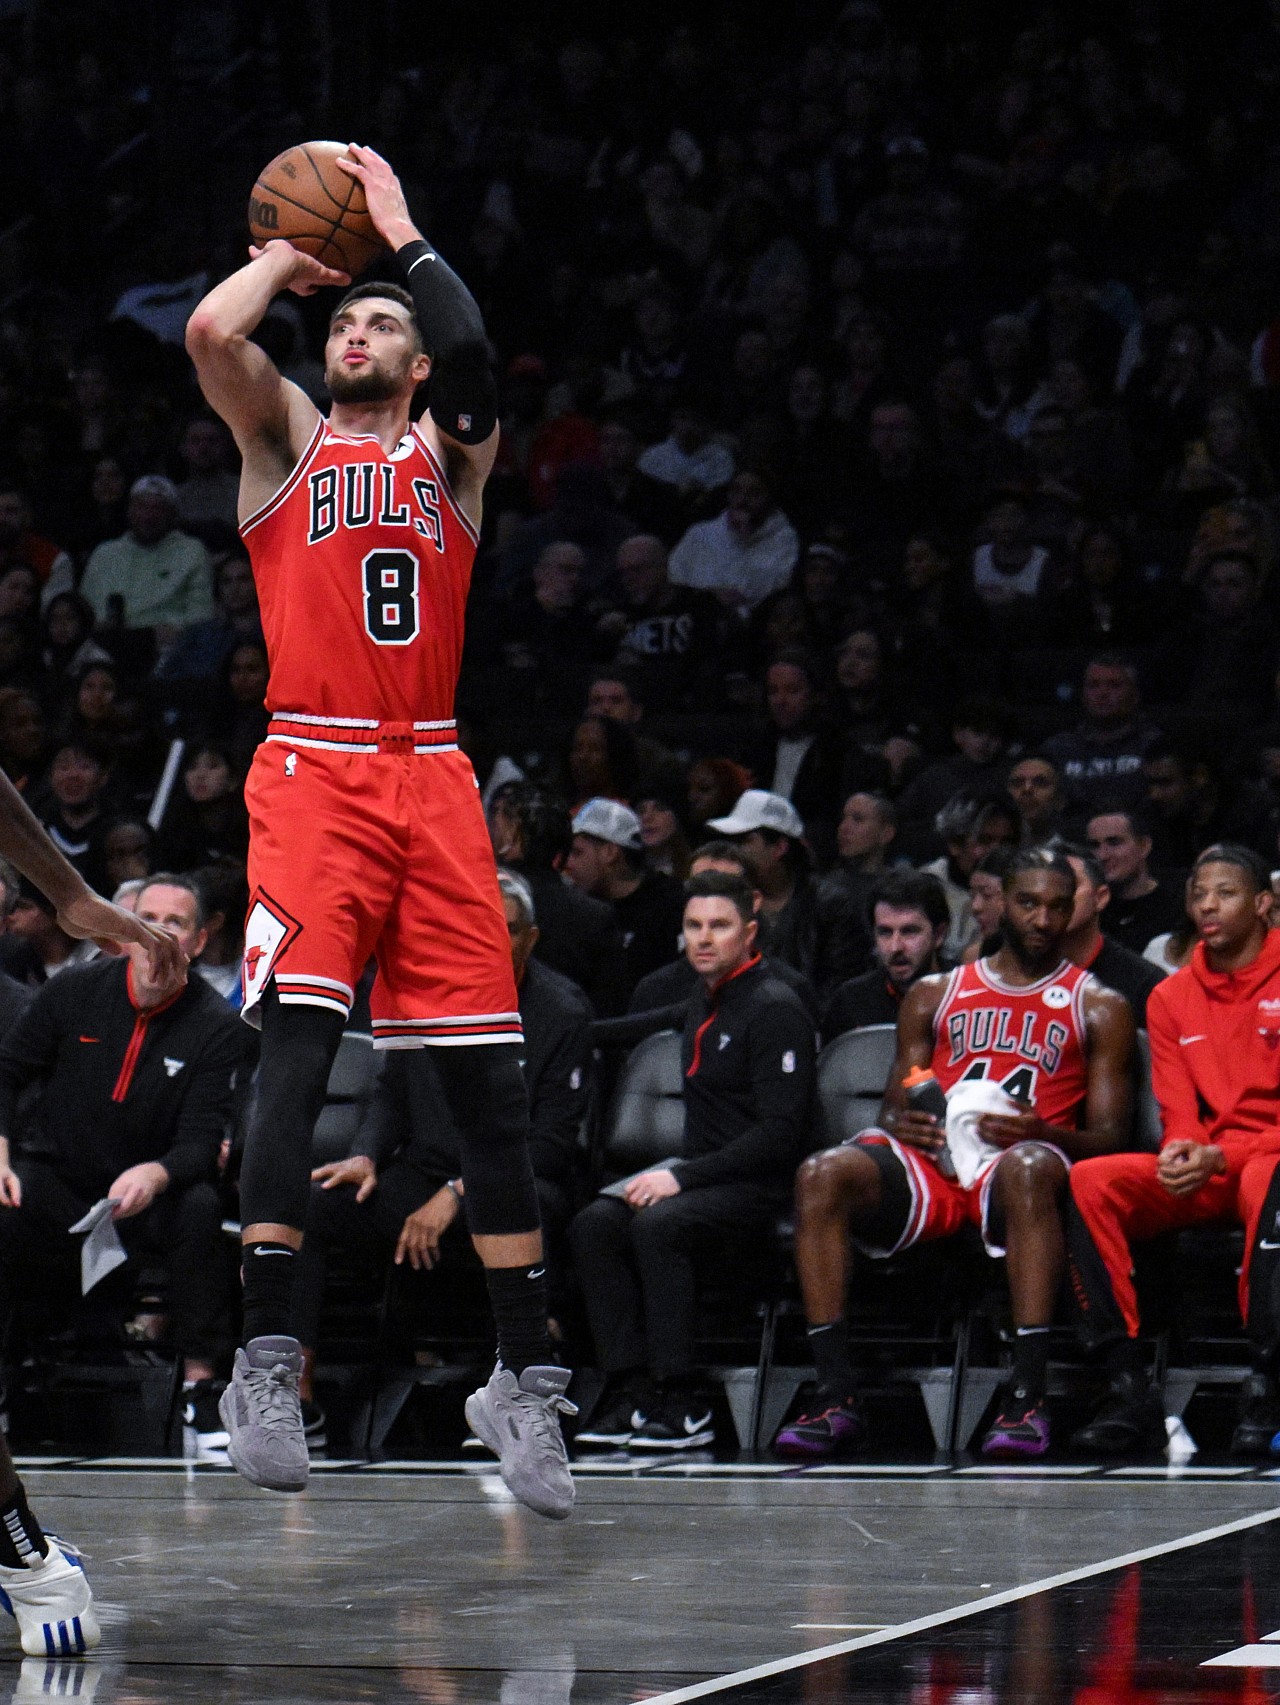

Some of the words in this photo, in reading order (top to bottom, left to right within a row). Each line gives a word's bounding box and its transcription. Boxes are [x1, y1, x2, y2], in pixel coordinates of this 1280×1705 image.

[361, 548, 420, 646] 8
[622, 614, 693, 653] ETS
[948, 1007, 1070, 1076] BULLS
